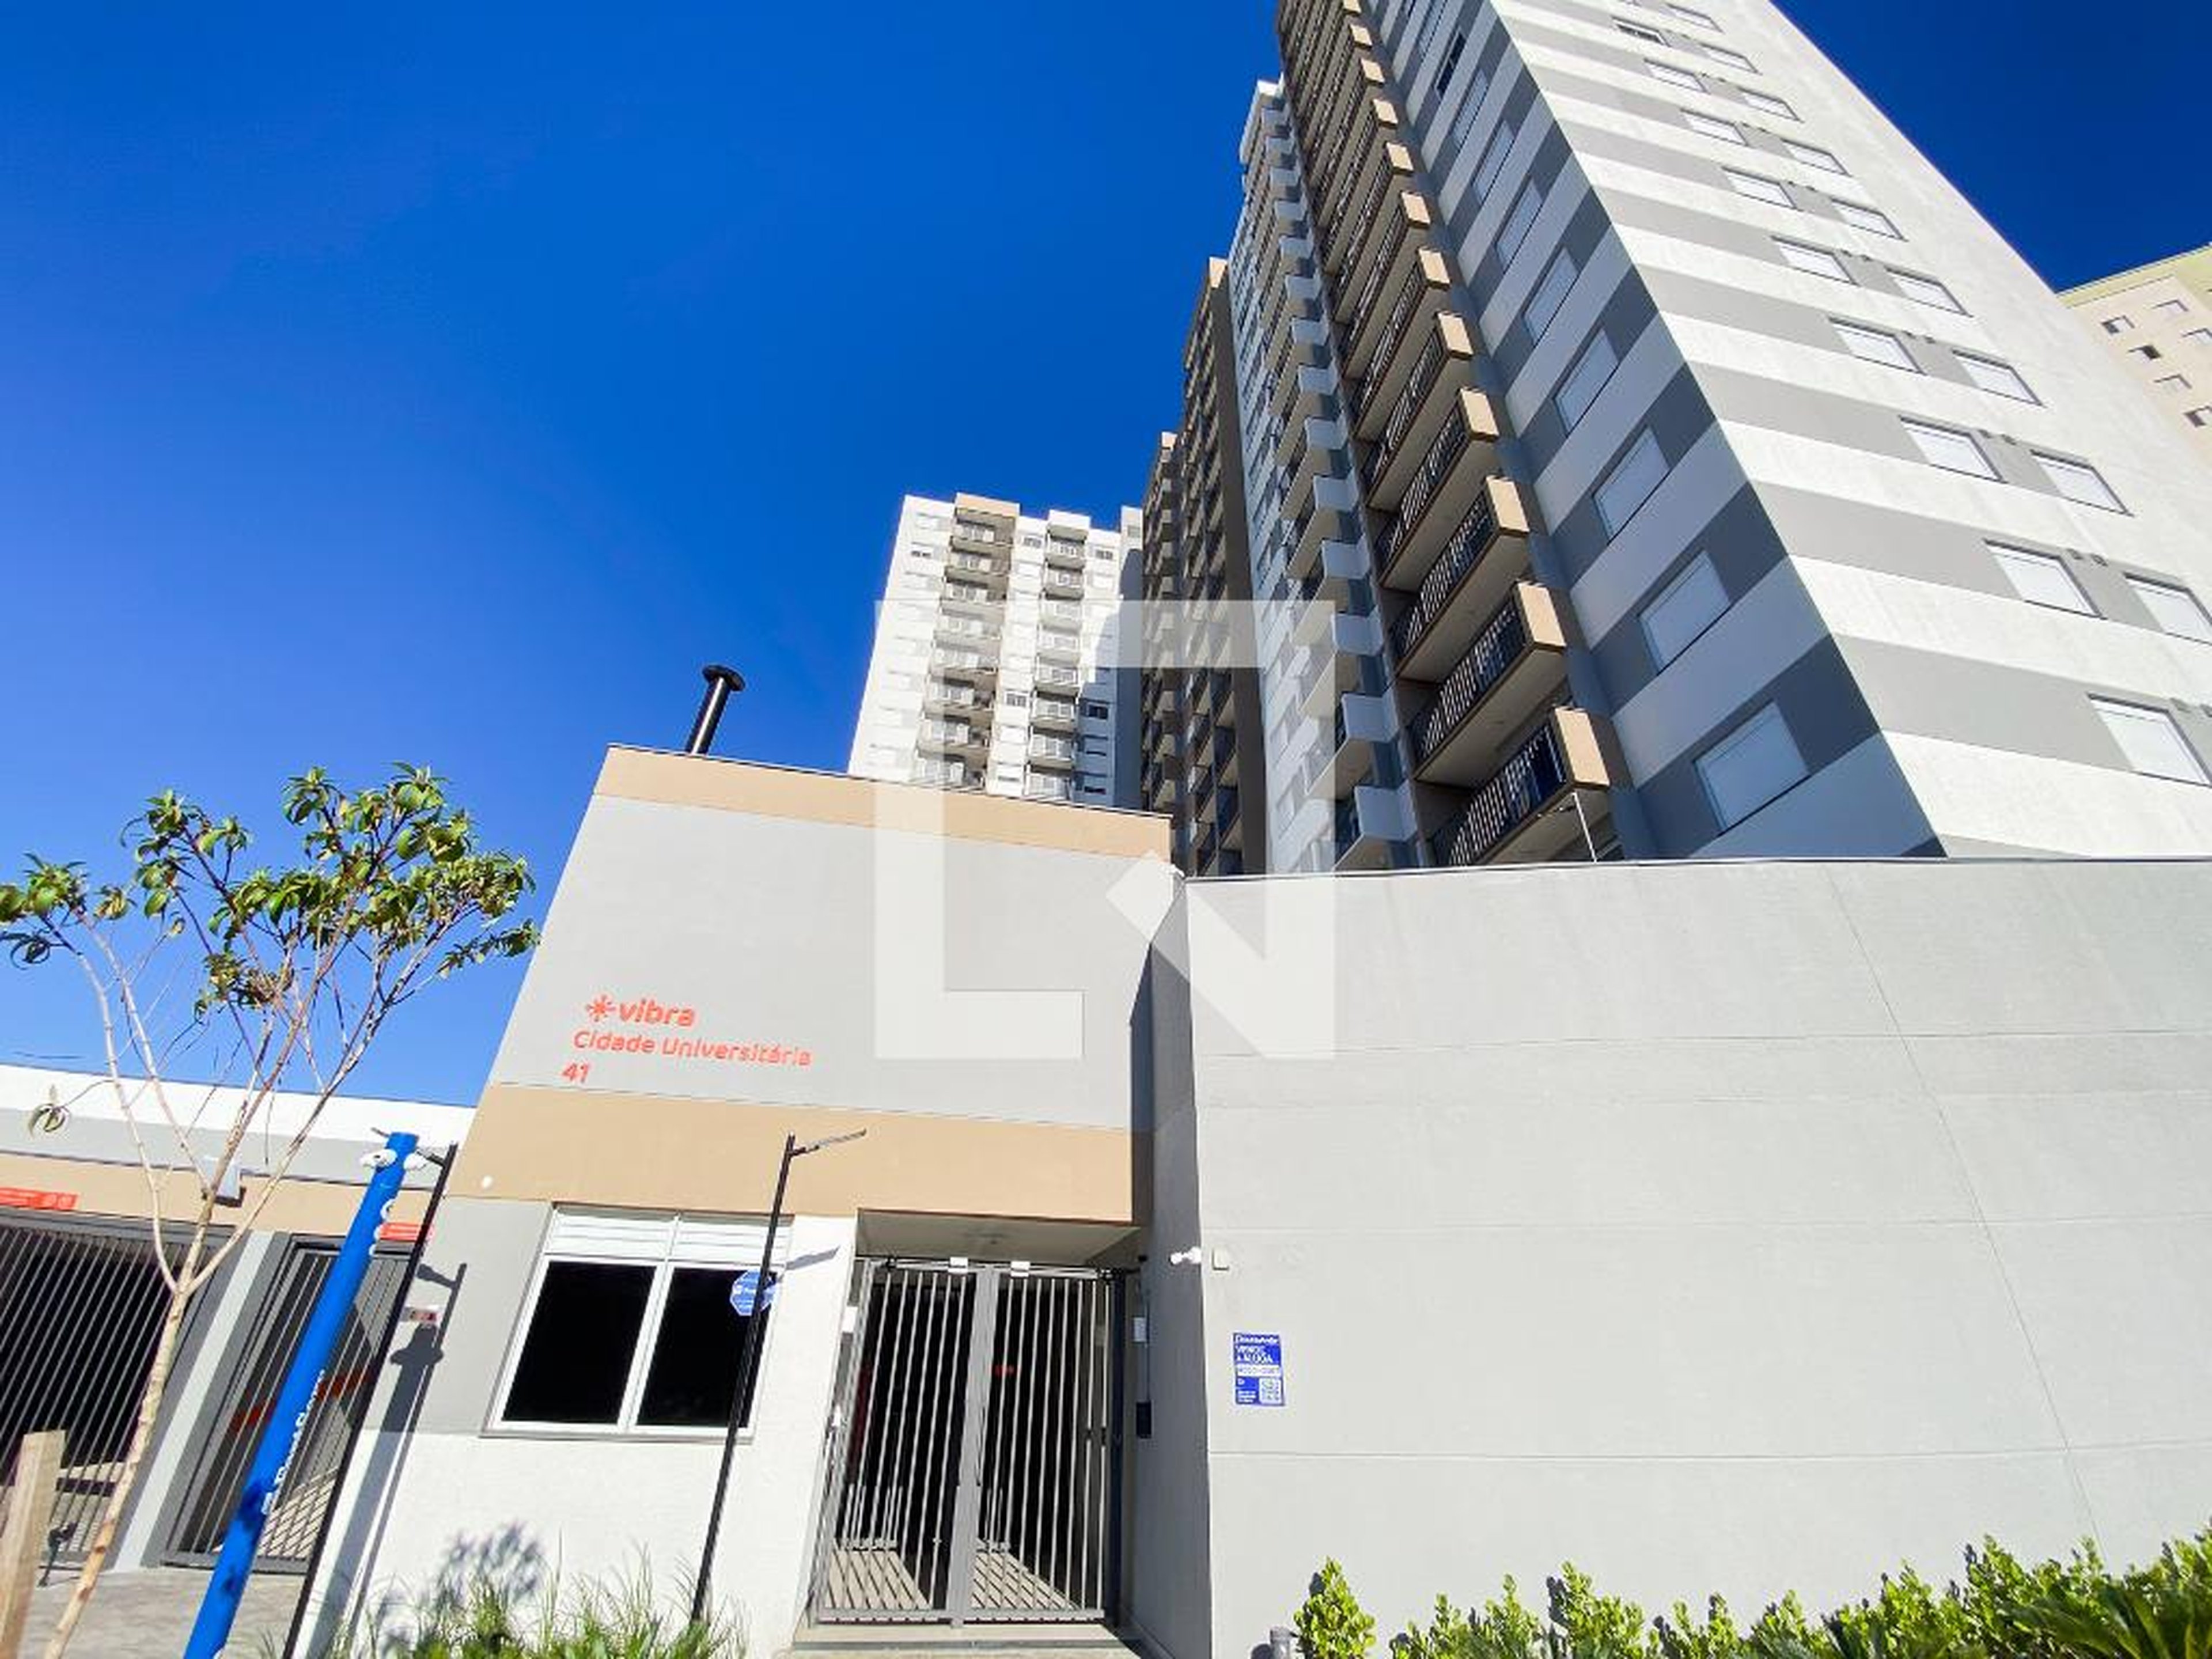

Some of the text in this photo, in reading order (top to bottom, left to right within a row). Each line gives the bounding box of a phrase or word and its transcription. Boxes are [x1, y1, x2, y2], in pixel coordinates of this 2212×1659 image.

[619, 998, 695, 1027] vibra
[573, 1030, 812, 1066] Cidade Universitária
[562, 1063, 589, 1082] 41
